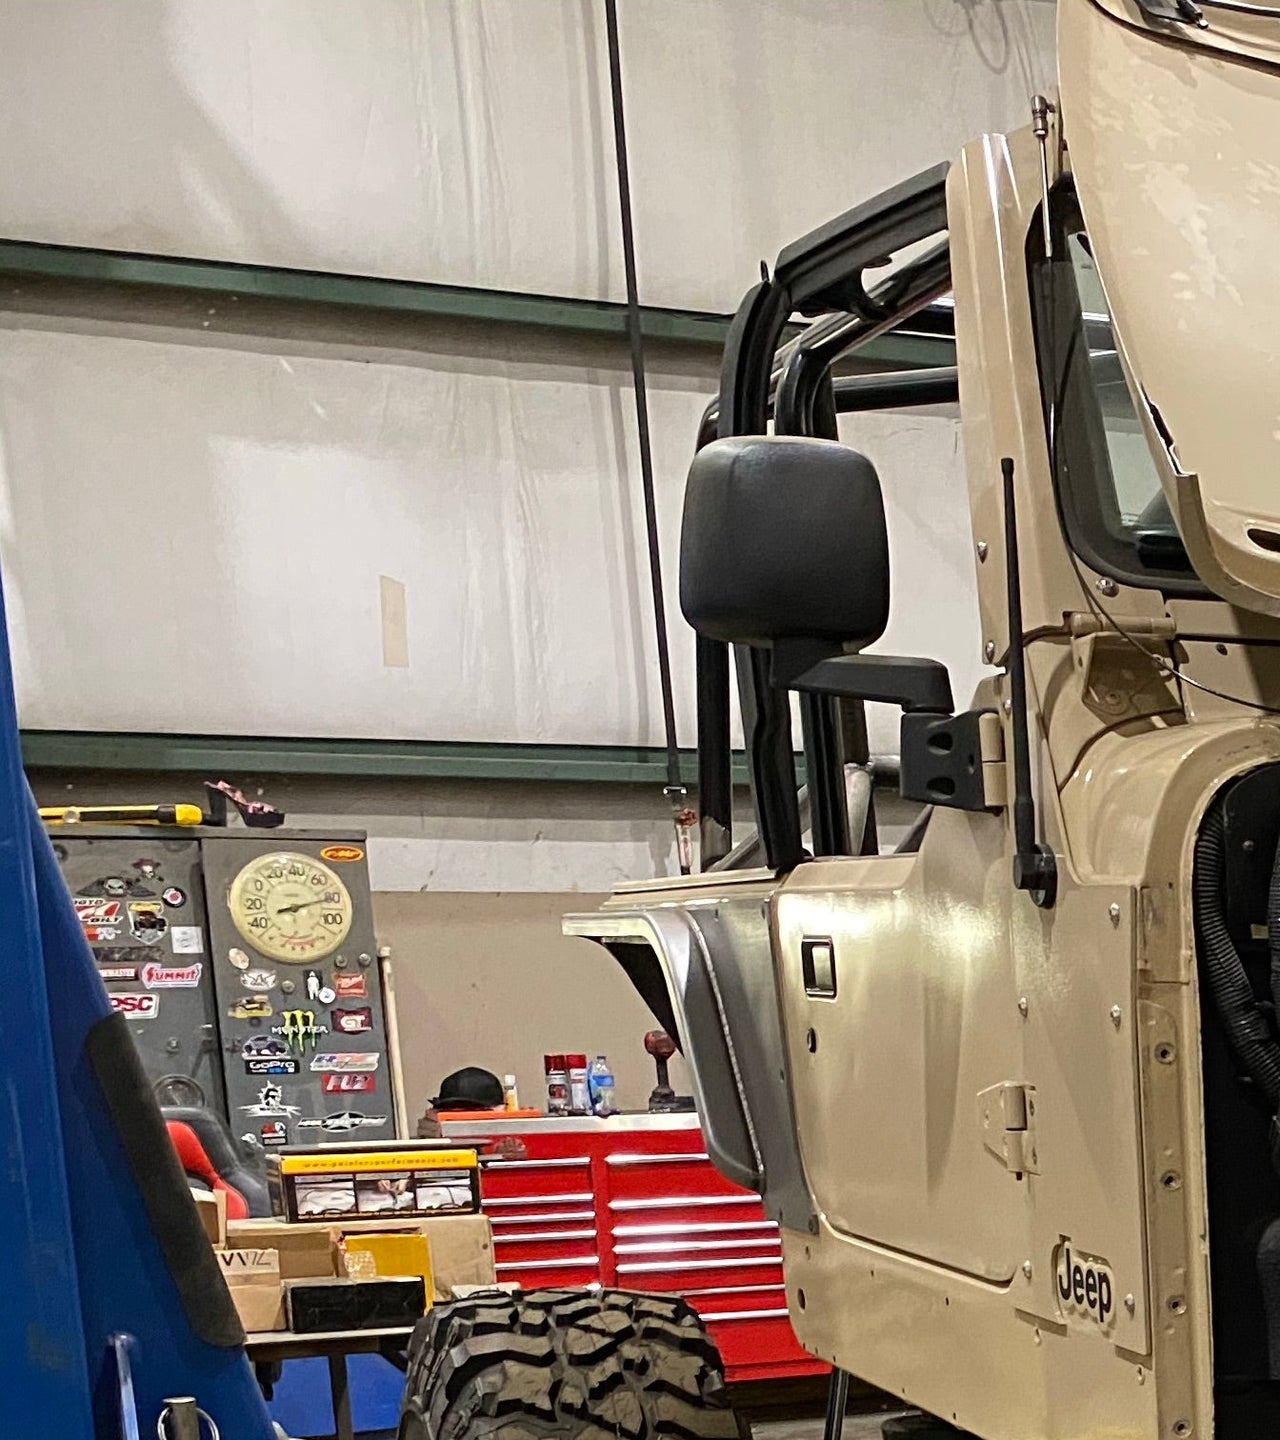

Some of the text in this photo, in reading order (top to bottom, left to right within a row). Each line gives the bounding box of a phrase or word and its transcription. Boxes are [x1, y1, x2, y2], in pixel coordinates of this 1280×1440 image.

[288, 863, 305, 877] 40
[254, 879, 264, 892] 0
[311, 874, 328, 886] 60
[324, 892, 341, 904] 80
[322, 912, 343, 925] 100
[249, 1060, 295, 1069] GoPro
[1058, 1247, 1112, 1323] Jeep
